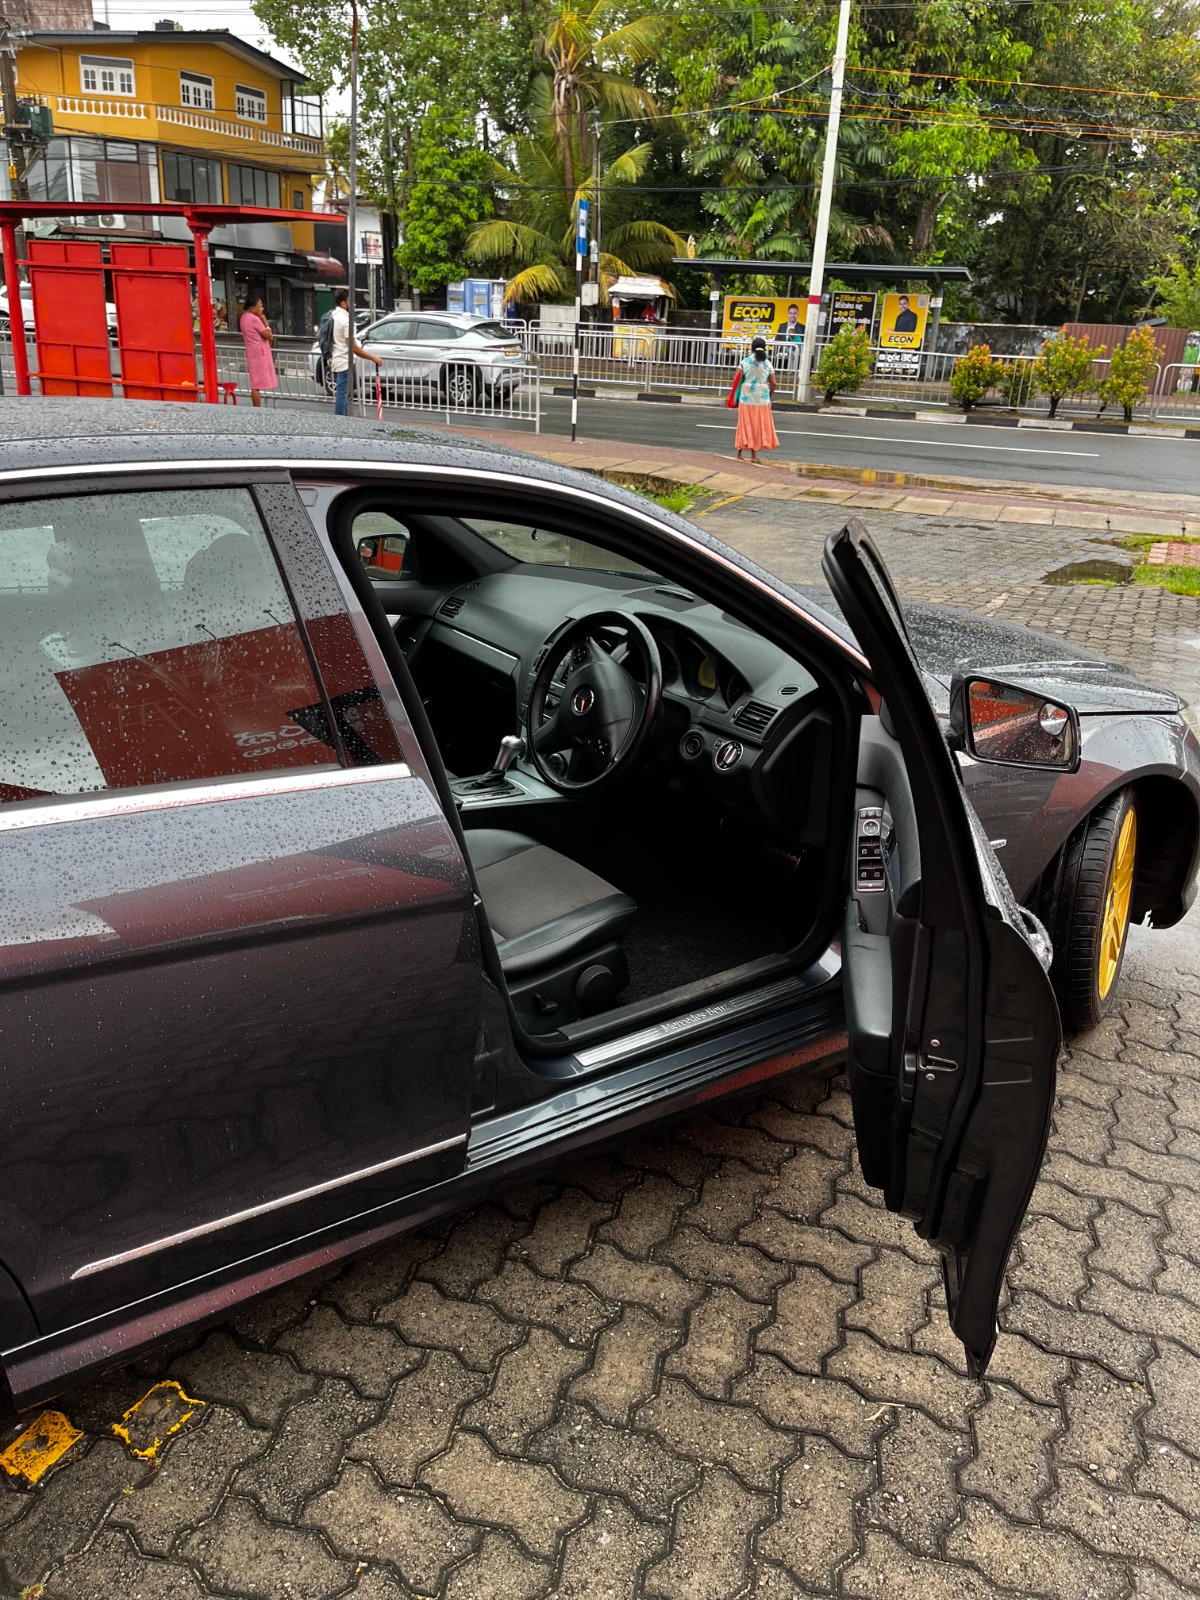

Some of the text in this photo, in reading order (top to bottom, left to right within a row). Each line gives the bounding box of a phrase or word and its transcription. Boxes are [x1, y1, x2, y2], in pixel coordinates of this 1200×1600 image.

[733, 306, 771, 319] ECON
[888, 335, 914, 344] ECON
[660, 1003, 731, 1033] Mercedes-Benz
